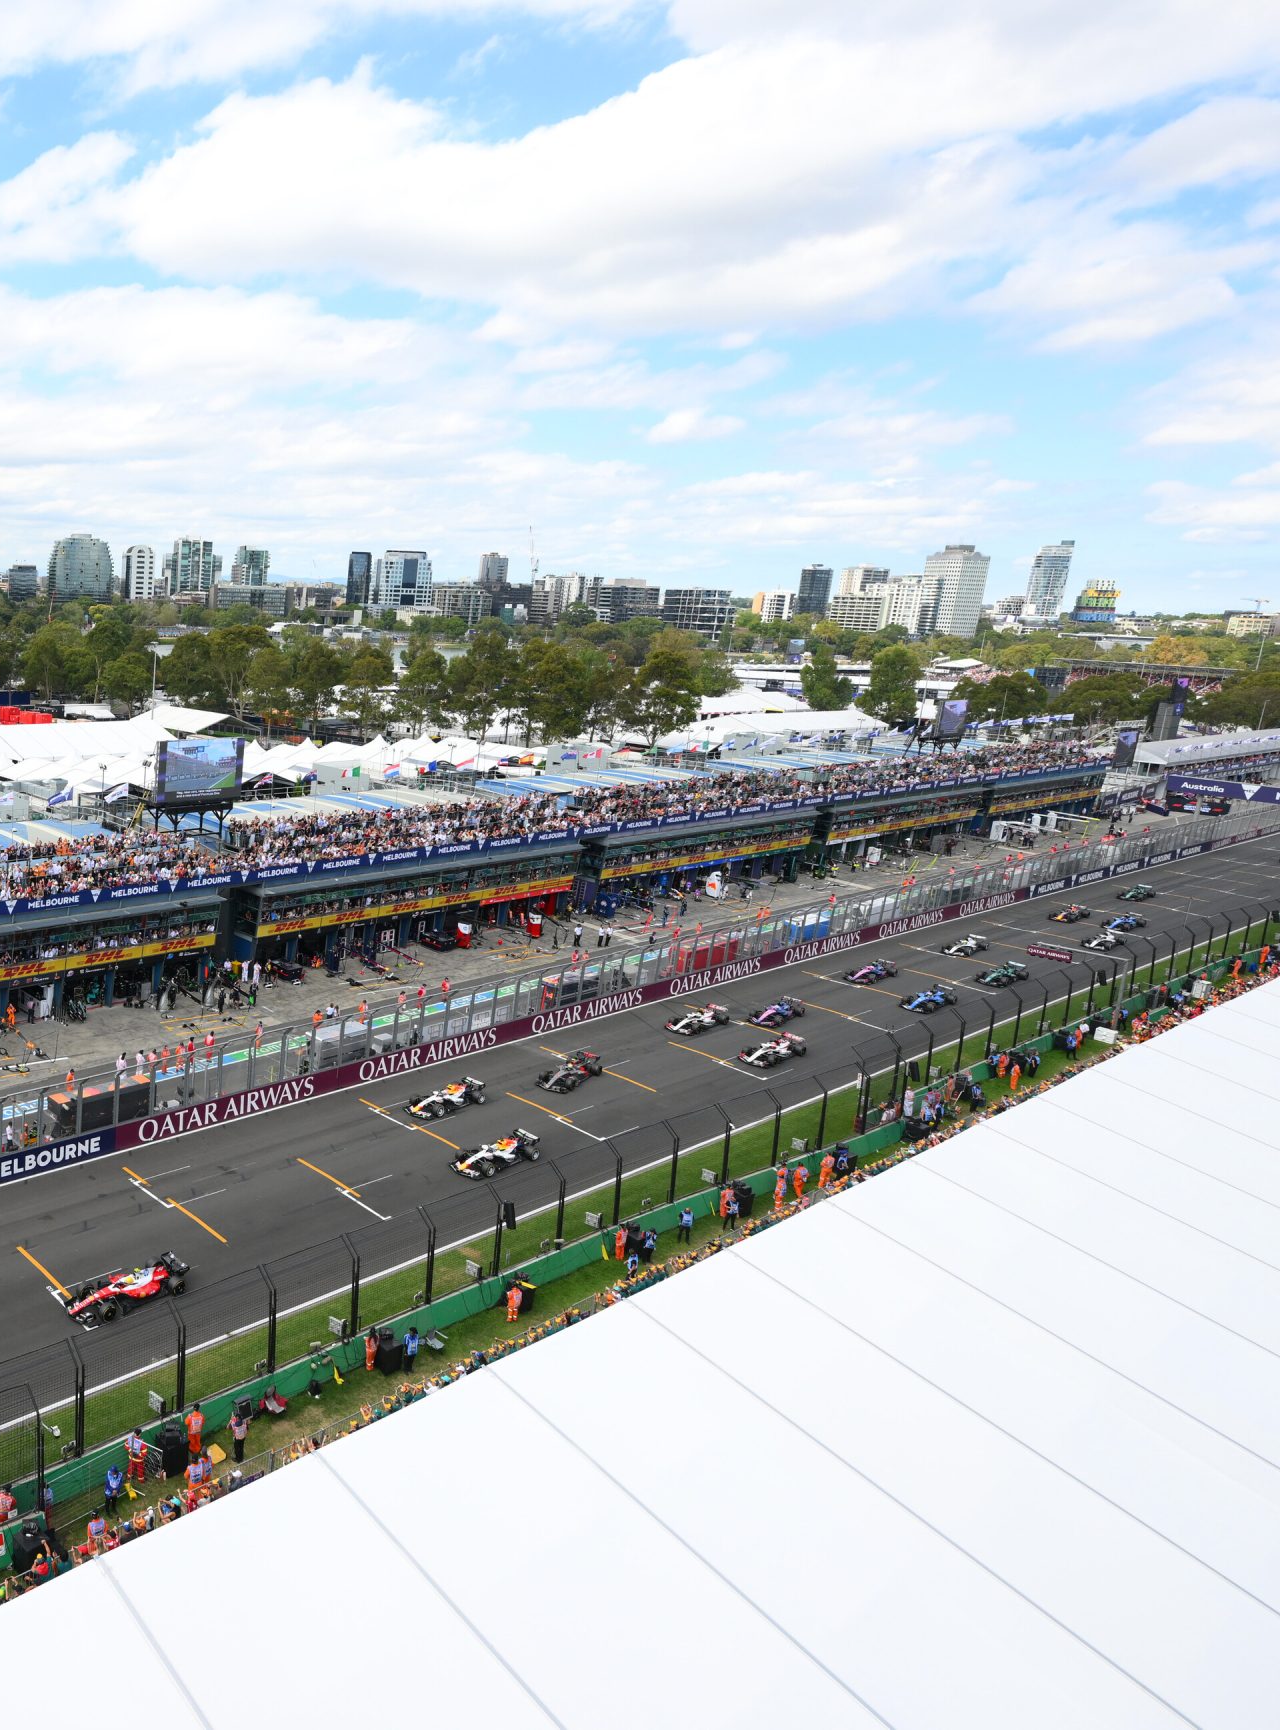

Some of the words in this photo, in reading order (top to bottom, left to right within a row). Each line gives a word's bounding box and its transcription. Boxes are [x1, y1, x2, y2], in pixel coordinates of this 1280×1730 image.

[1181, 781, 1225, 794] Australia
[538, 832, 568, 841] MELBOURNE
[584, 825, 611, 835] MELBOURNE
[438, 844, 471, 854] MELBOURNE
[490, 838, 521, 848] MELBOURNE
[382, 851, 418, 862] MELBOURNE
[1150, 853, 1171, 865] MELBOURNE
[323, 858, 361, 870] MELBOURNE
[1116, 861, 1139, 874] MELBOURNE
[257, 867, 298, 878] MELBOURNE
[1078, 870, 1104, 884] MELBOURNE
[188, 875, 231, 888] MELBOURNE
[1037, 880, 1065, 894] MELBOURNE
[111, 885, 159, 898] MELBOURNE
[494, 886, 519, 895] DHL
[28, 895, 80, 909] MELBOURNE
[445, 894, 471, 904] DHL
[959, 898, 986, 917] QATAR
[986, 891, 1016, 909] AIRWAYS
[392, 901, 421, 912] DHL
[335, 910, 367, 922] DHL
[274, 920, 306, 932] DHL
[879, 918, 907, 938] QATAR
[908, 908, 943, 929] AIRWAYS
[160, 937, 198, 951] DHL
[784, 940, 818, 964] QATAR
[819, 930, 861, 954] AIRWAYS
[85, 950, 126, 964] DHL
[1028, 948, 1046, 956] QATAR
[1047, 951, 1070, 960] AIRWAYS
[3, 962, 48, 977] DHL
[670, 967, 718, 996] QATAR
[720, 956, 761, 985] AIRWAYS
[532, 1004, 581, 1033] QATAR
[585, 988, 643, 1018] AIRWAYS
[359, 1050, 420, 1081] QATAR
[425, 1028, 497, 1061] AIRWAYS
[138, 1102, 219, 1142] QATAR
[224, 1076, 314, 1119] AIRWAYS
